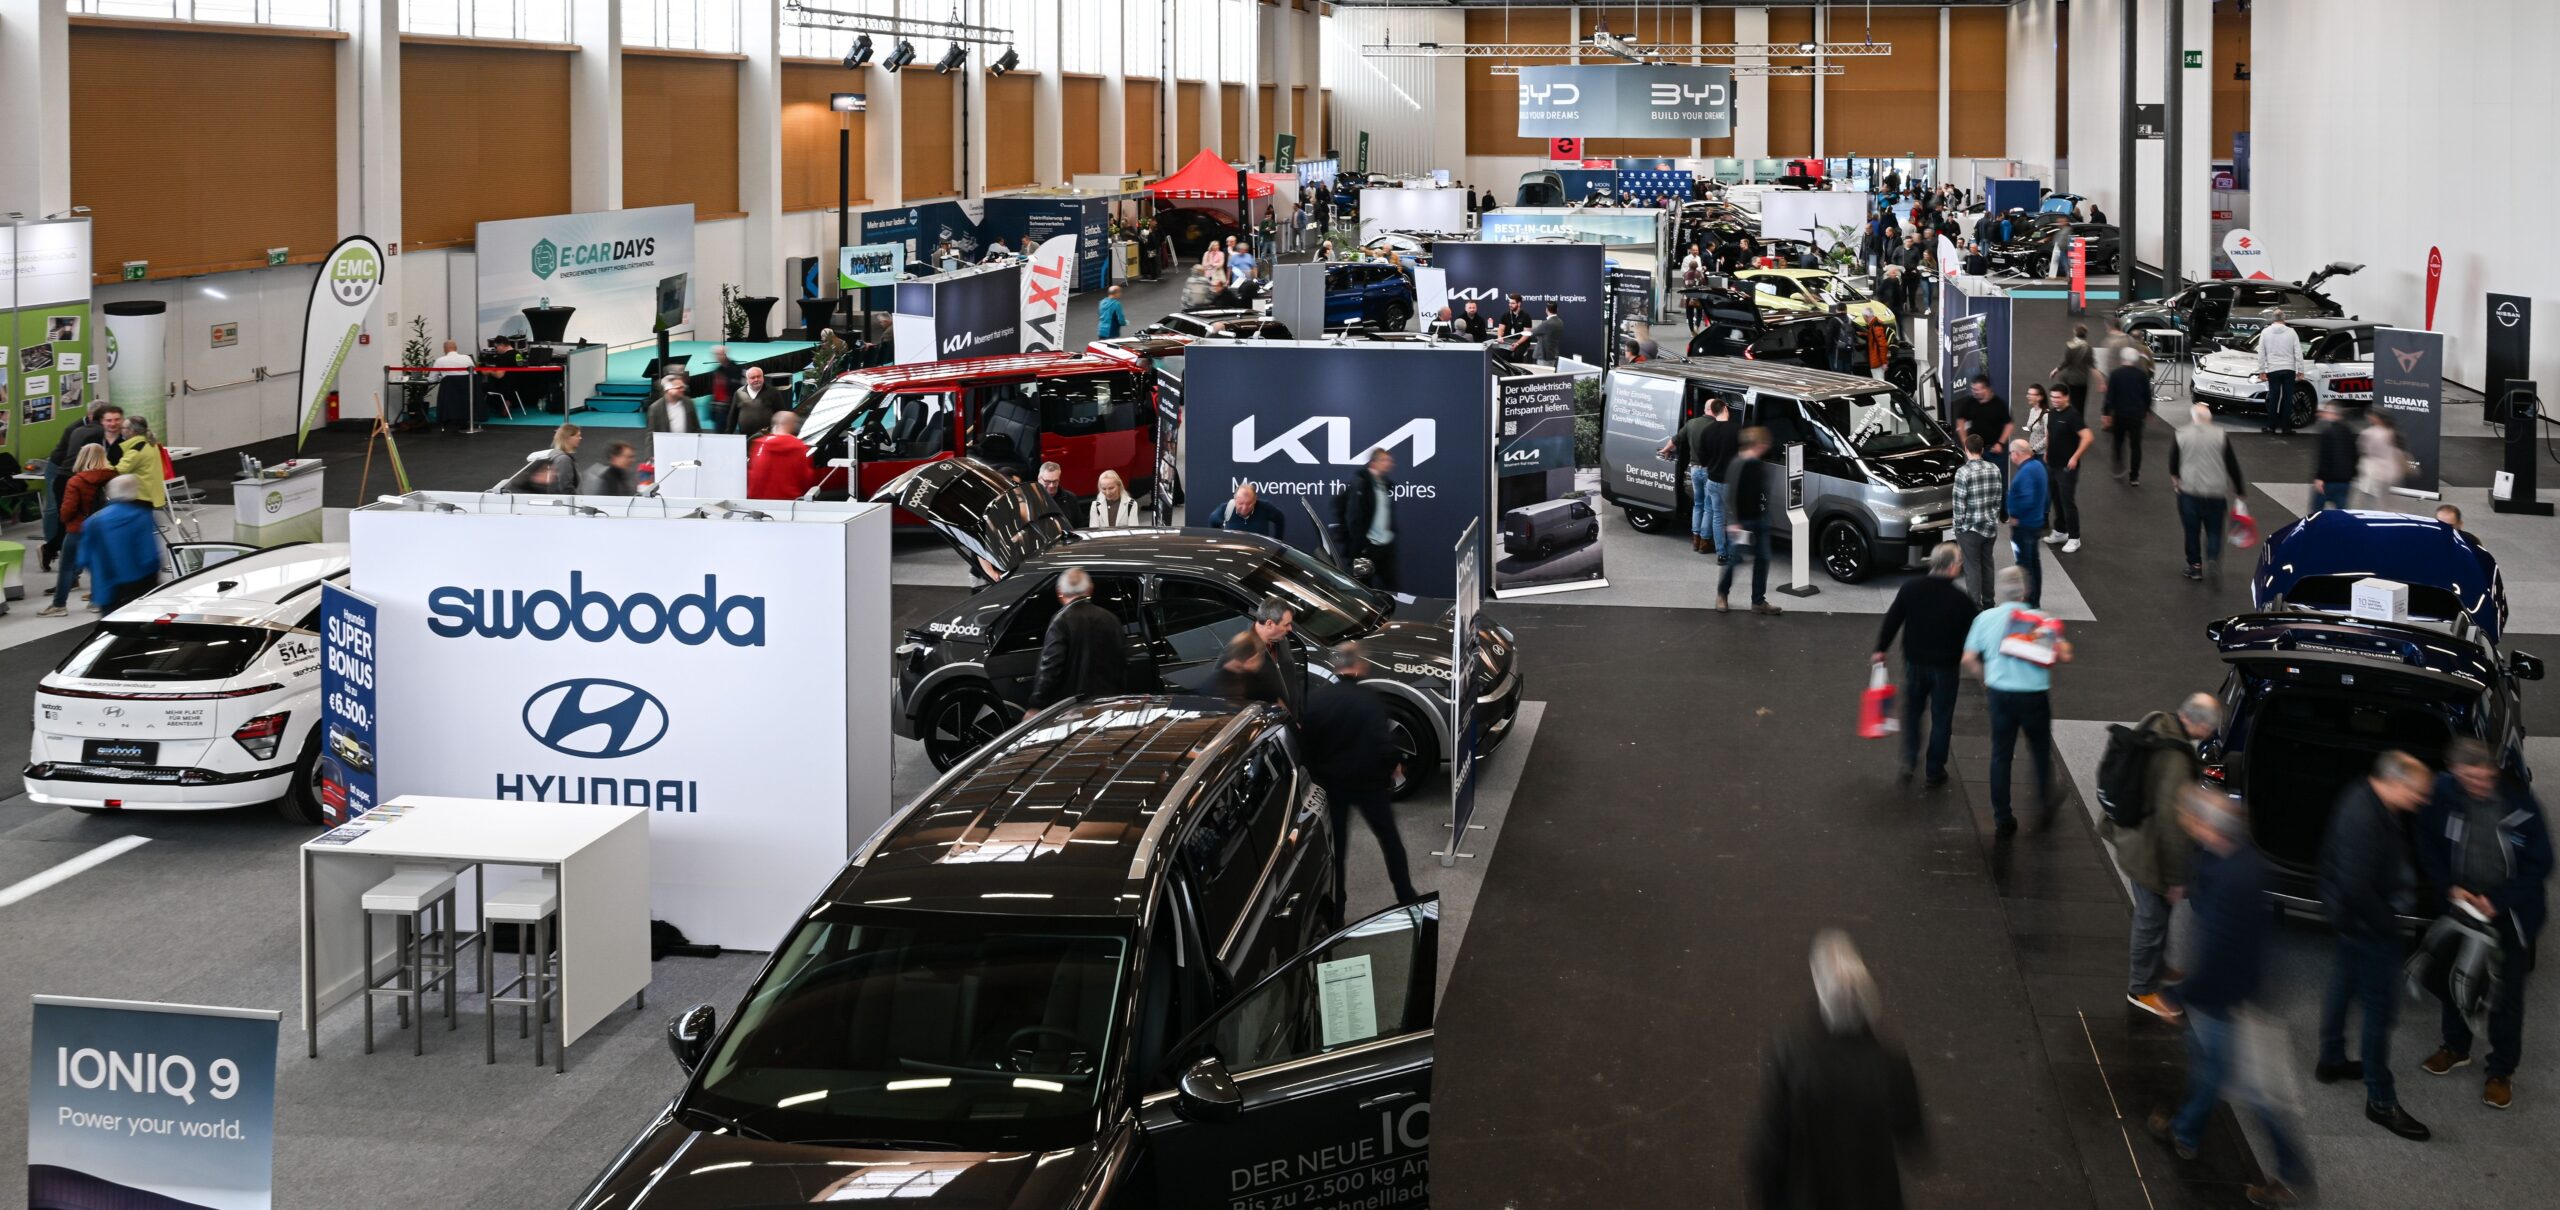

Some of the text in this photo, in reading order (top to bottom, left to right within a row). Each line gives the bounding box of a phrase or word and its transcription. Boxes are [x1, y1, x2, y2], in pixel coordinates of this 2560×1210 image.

[1651, 84, 1726, 105] BYD
[1529, 112, 1545, 120] YOUR
[1546, 111, 1579, 120] DREAMS
[1651, 111, 1726, 120] BUILD YOUR DREAMS
[1161, 189, 1228, 198] TESLA
[867, 220, 879, 229] Mehr
[613, 237, 655, 260] DAYS
[337, 259, 374, 277] EMC
[560, 268, 598, 279] ENERGIEWENDE
[598, 265, 613, 274] TRIFFT
[1448, 287, 1499, 300] KIA
[1505, 293, 1587, 303] Mement that inspires
[2496, 310, 2521, 318] NISSAN
[943, 331, 972, 354] KIA
[974, 332, 994, 345] Movement
[1505, 381, 1572, 395] Der vollelektrische
[1953, 377, 1967, 388] KIA
[1505, 394, 1561, 405] Kia PV5 Cargo.
[2384, 396, 2429, 408] LUGMAYR
[1504, 403, 1570, 416] Entspannt liefern.
[1232, 414, 1437, 467] KIA
[1504, 448, 1540, 461] KIA
[1626, 464, 1676, 483] Der neue PV5
[1626, 475, 1674, 492] Ein starker Partner
[427, 570, 765, 647] swoboda
[343, 608, 366, 628] Hyundai
[929, 620, 981, 636] swoboda
[328, 616, 373, 661] SUPER
[279, 643, 308, 661] 514
[2300, 643, 2334, 652] TOYOTA
[2359, 651, 2401, 660] TOURING
[328, 645, 373, 690] BONUS
[41, 703, 63, 711] swoboda
[496, 773, 697, 812] HYUNDAI
[58, 1046, 240, 1105] IONIQ 9
[58, 1106, 246, 1140] Power your world.
[1231, 1158, 1291, 1192] DER
[1298, 1137, 1375, 1175] NEUE
[1272, 1191, 1298, 1210] zu
[1303, 1172, 1365, 1202] 2.500
[1371, 1166, 1396, 1187] kg
